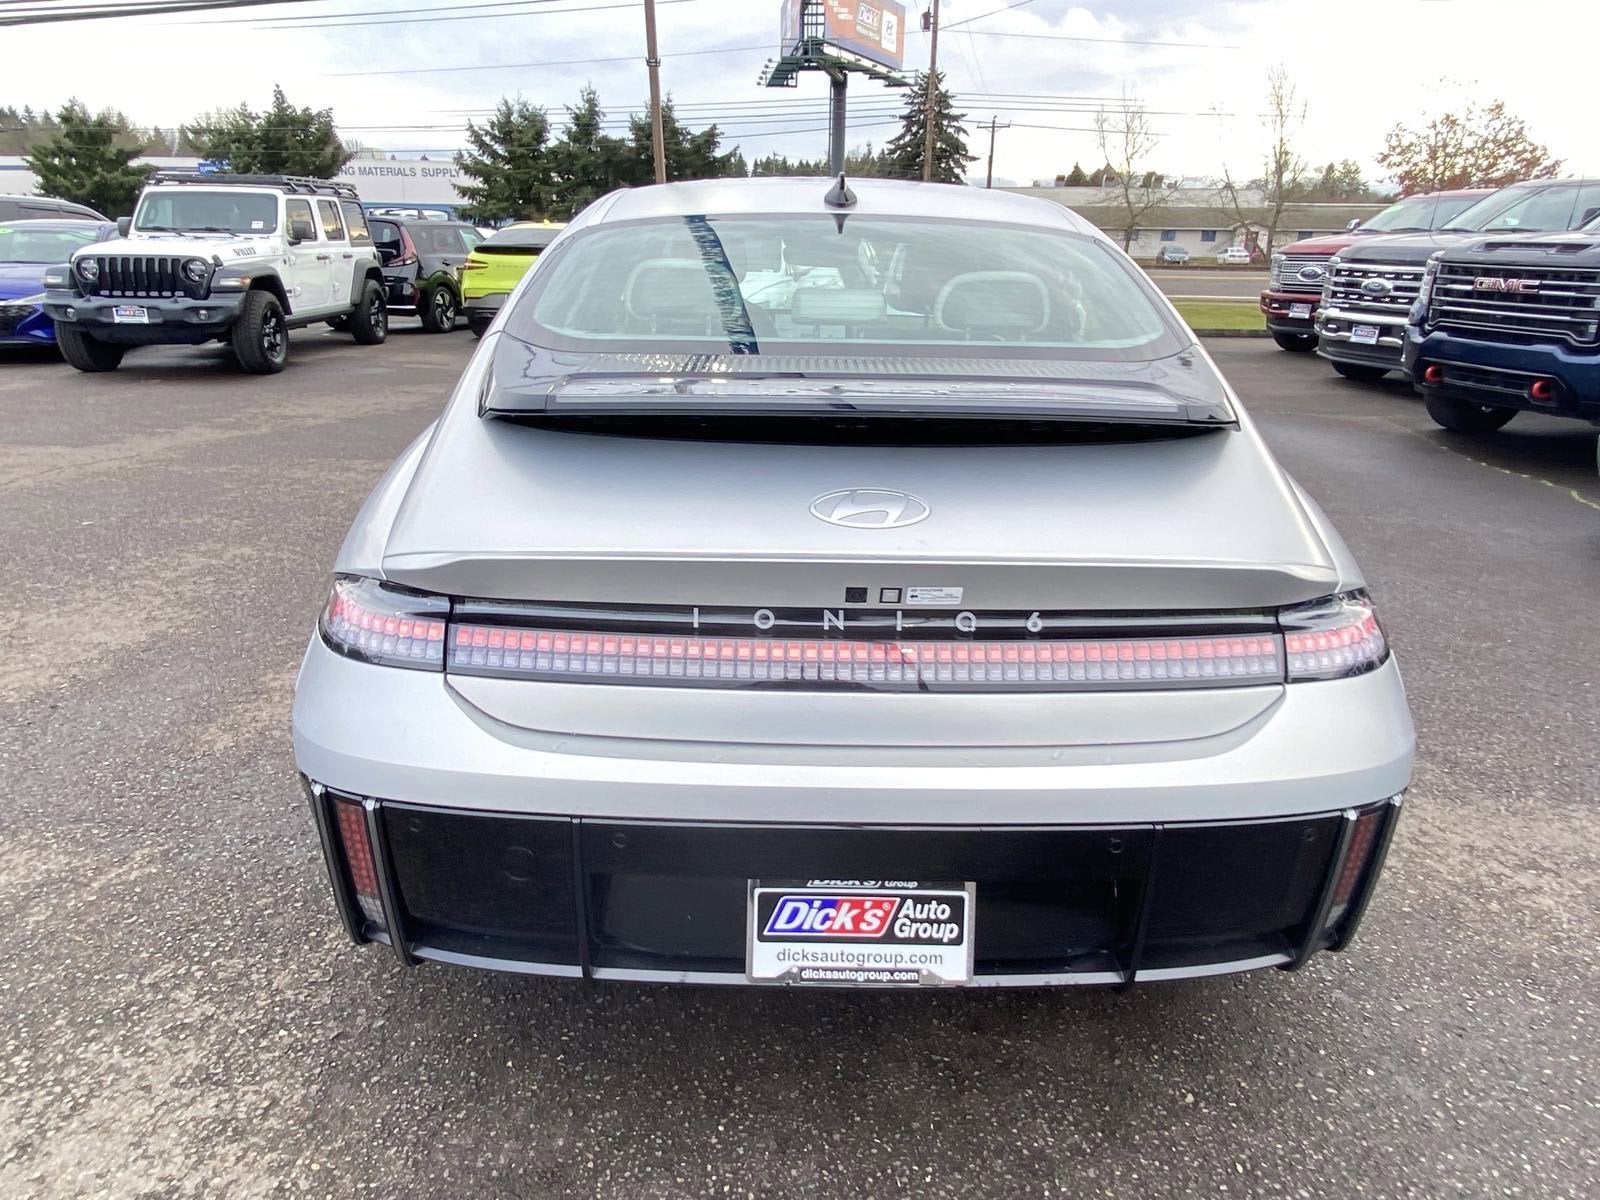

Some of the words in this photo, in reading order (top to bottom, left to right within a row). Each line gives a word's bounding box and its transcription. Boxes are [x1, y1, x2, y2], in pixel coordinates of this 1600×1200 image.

[358, 166, 416, 177] MATERIALS
[421, 167, 461, 178] SUPPLY
[1473, 276, 1541, 294] GMC
[692, 607, 976, 633] IONIQ
[1025, 611, 1043, 633] 6
[898, 898, 951, 920] Auto
[893, 917, 959, 943] Group
[776, 948, 944, 966] dicksautogroup.com
[801, 968, 919, 982] dicksautogroup.com
